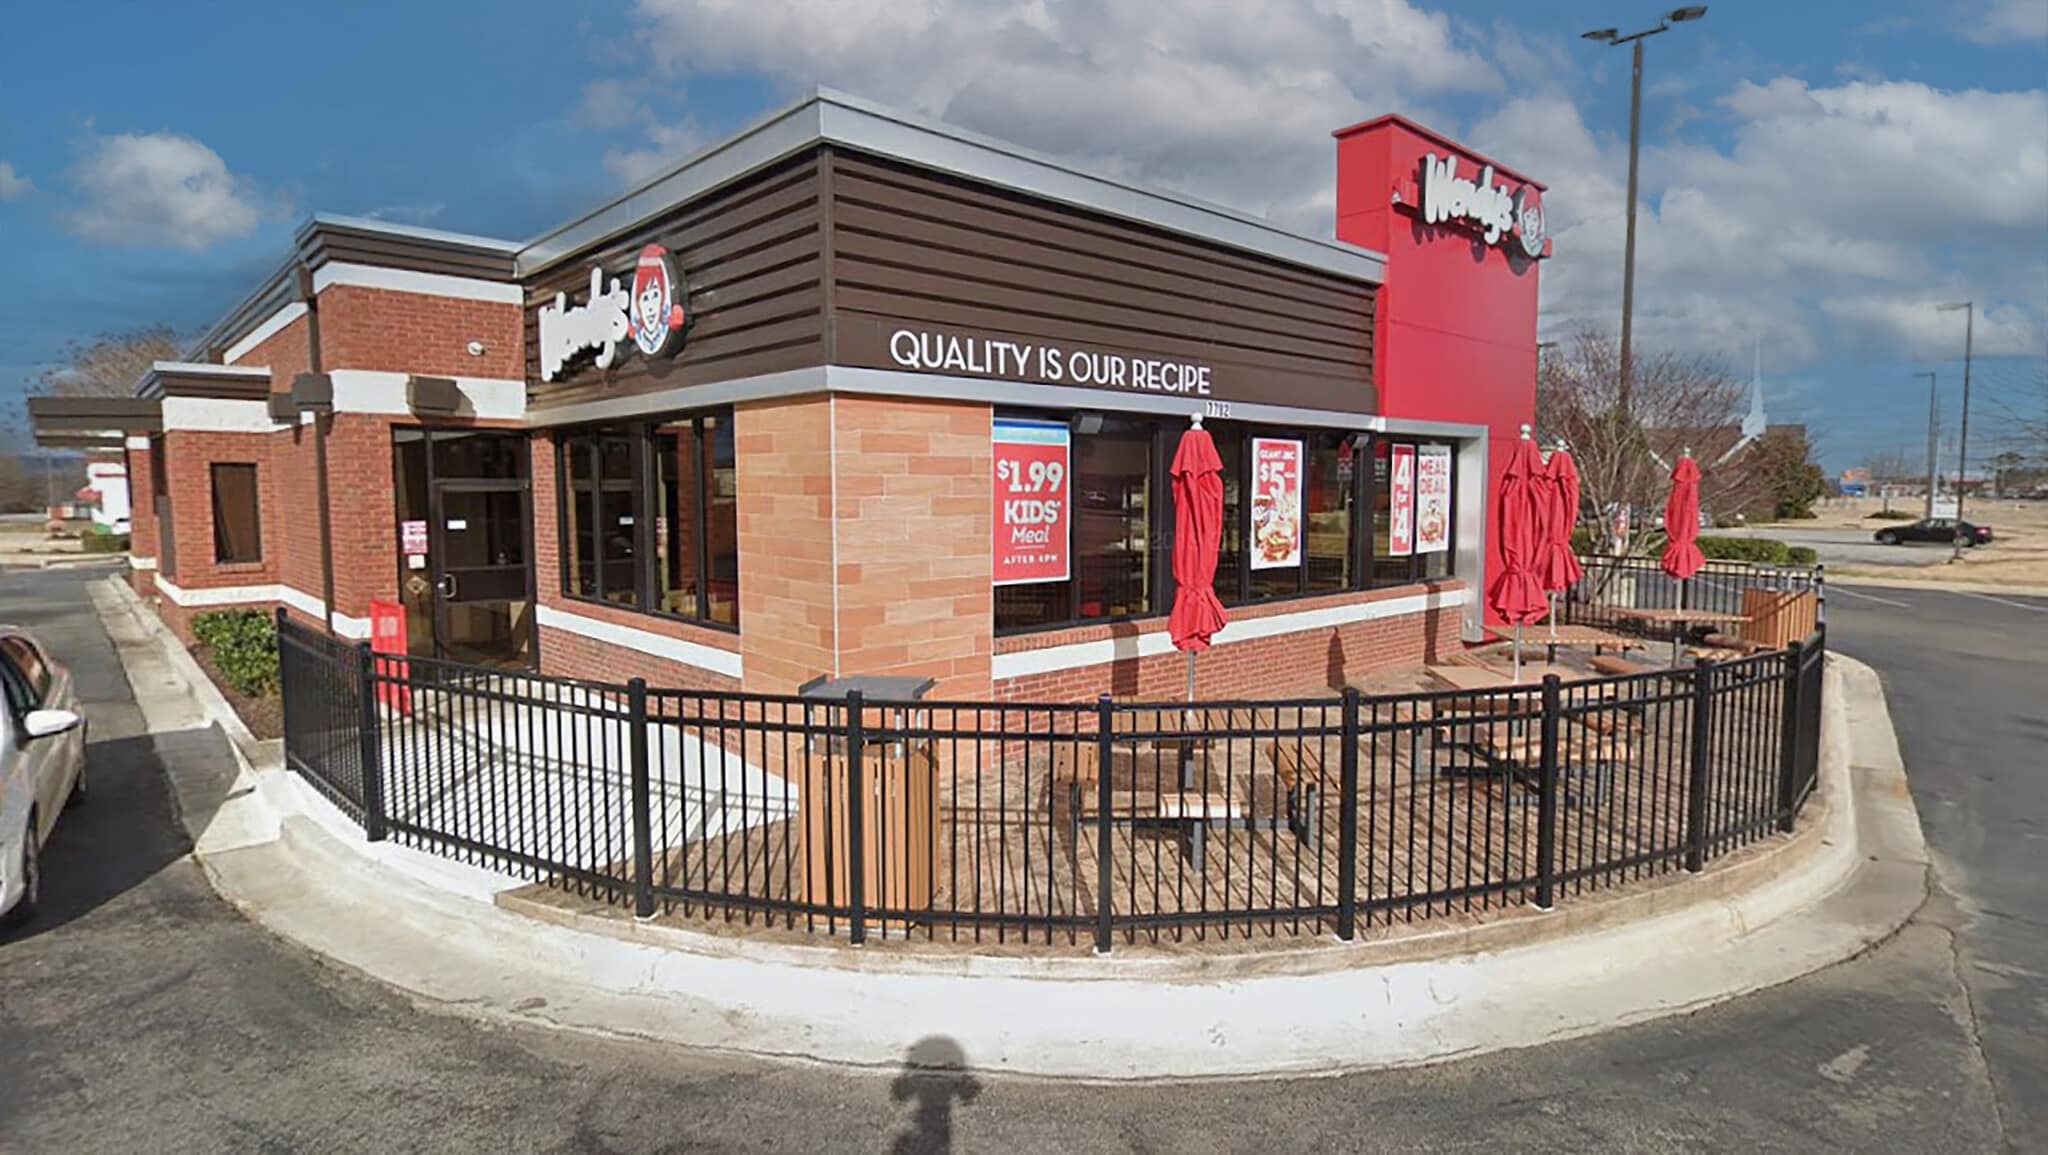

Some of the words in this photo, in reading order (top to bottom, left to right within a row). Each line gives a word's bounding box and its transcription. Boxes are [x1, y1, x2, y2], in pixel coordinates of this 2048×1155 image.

[1425, 153, 1513, 244] Wendy's
[538, 266, 629, 382] Wendy's
[890, 330, 1031, 376] QUALITY
[1039, 347, 1063, 380] IS
[1069, 351, 1126, 386] OUR
[1132, 358, 1211, 395] RECIPE
[997, 459, 1064, 492] $1.99
[1012, 525, 1050, 544] Meal
